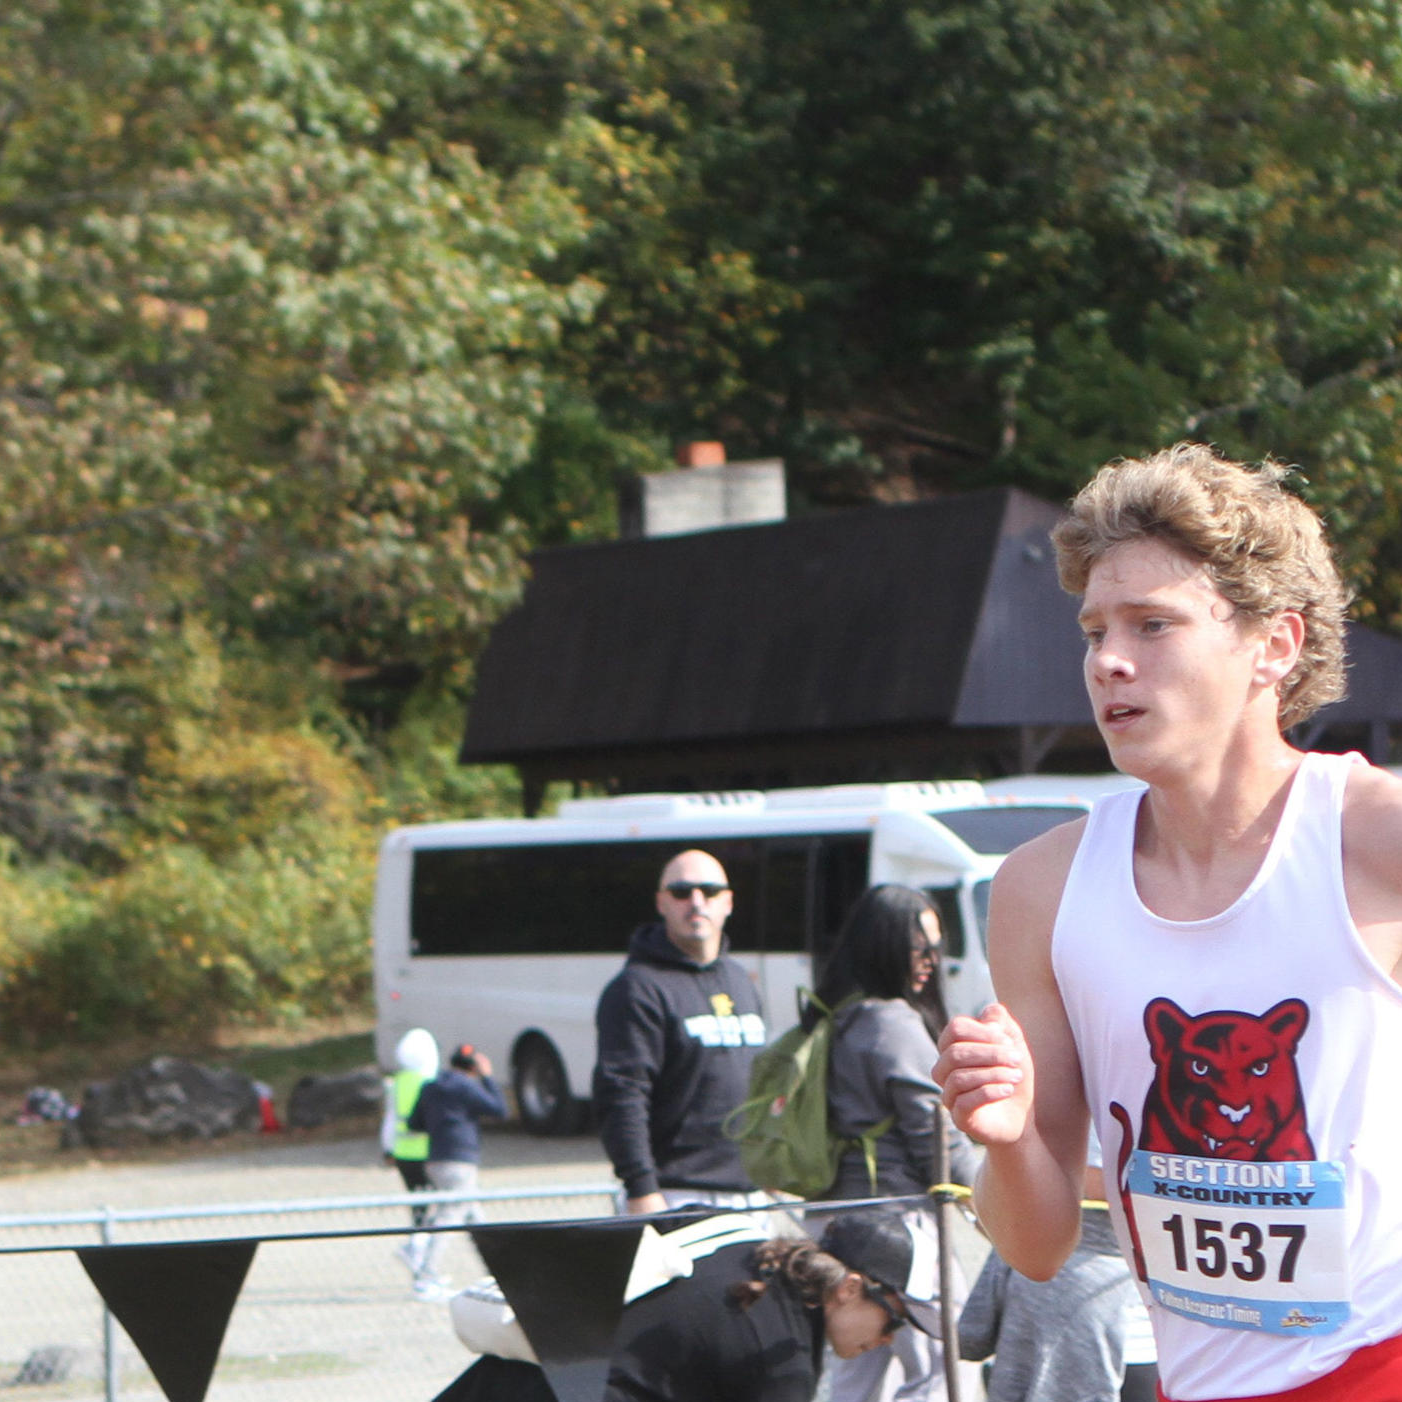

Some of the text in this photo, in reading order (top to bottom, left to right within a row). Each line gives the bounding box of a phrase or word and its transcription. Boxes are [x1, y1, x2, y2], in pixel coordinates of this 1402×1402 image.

[1150, 1155, 1315, 1188] SECTION 1
[1153, 1181, 1315, 1206] X-COUNTRY
[1162, 1213, 1307, 1283] 1537
[1226, 1303, 1262, 1327] Timing
